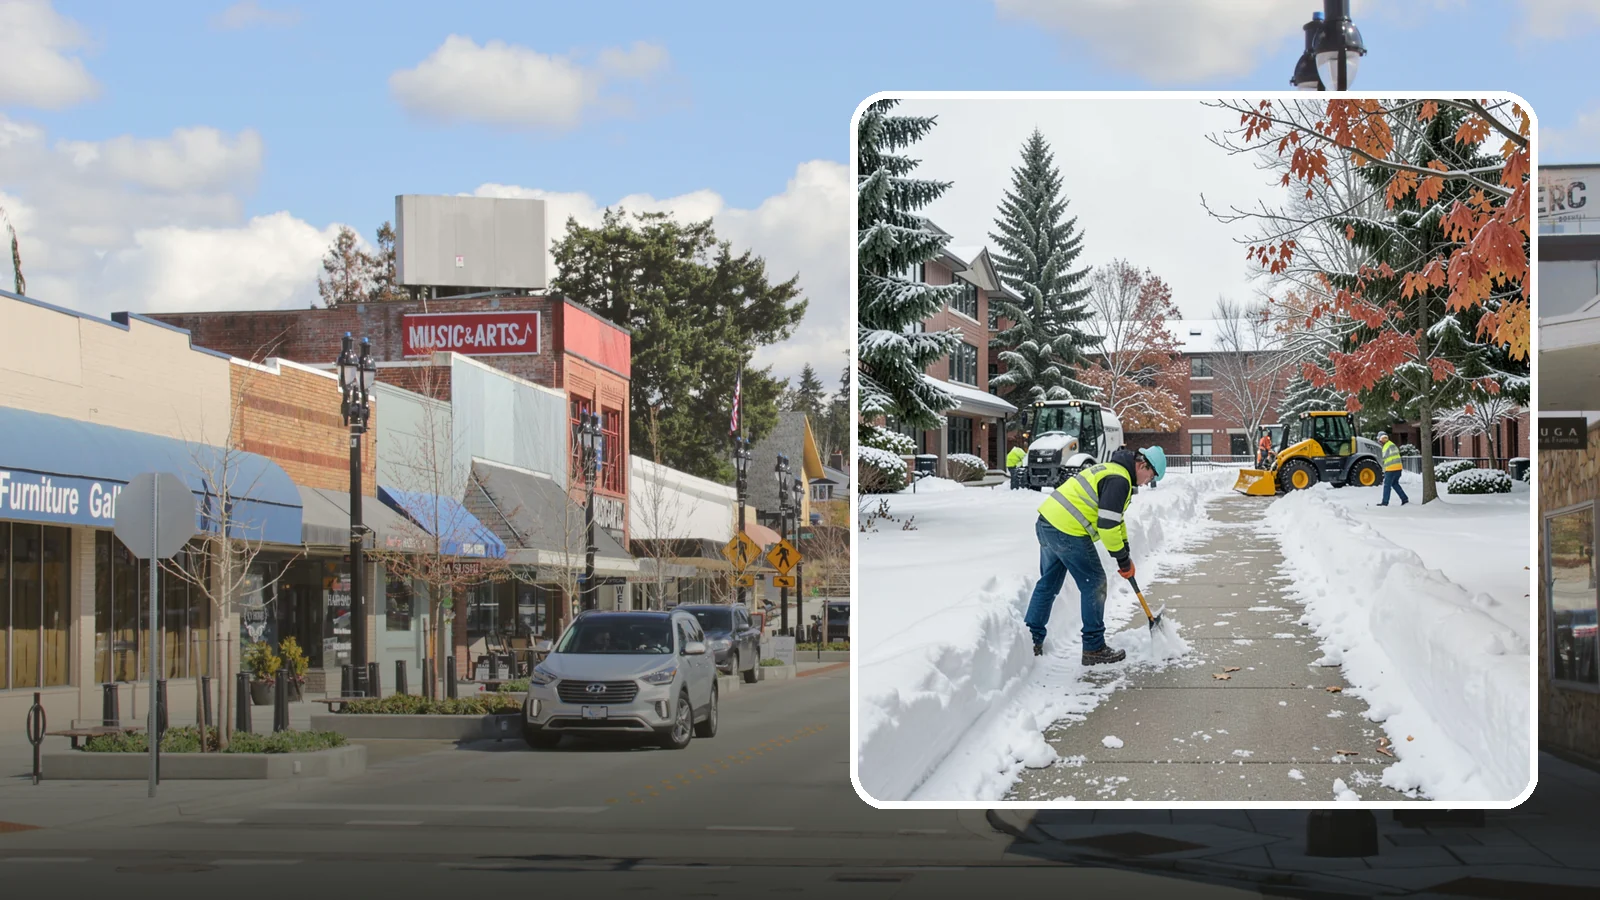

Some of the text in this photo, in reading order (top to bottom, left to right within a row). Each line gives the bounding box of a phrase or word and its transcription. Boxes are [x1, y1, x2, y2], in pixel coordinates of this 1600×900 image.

[0, 471, 122, 519] Furniture Gal
[453, 563, 479, 574] SUSHI
